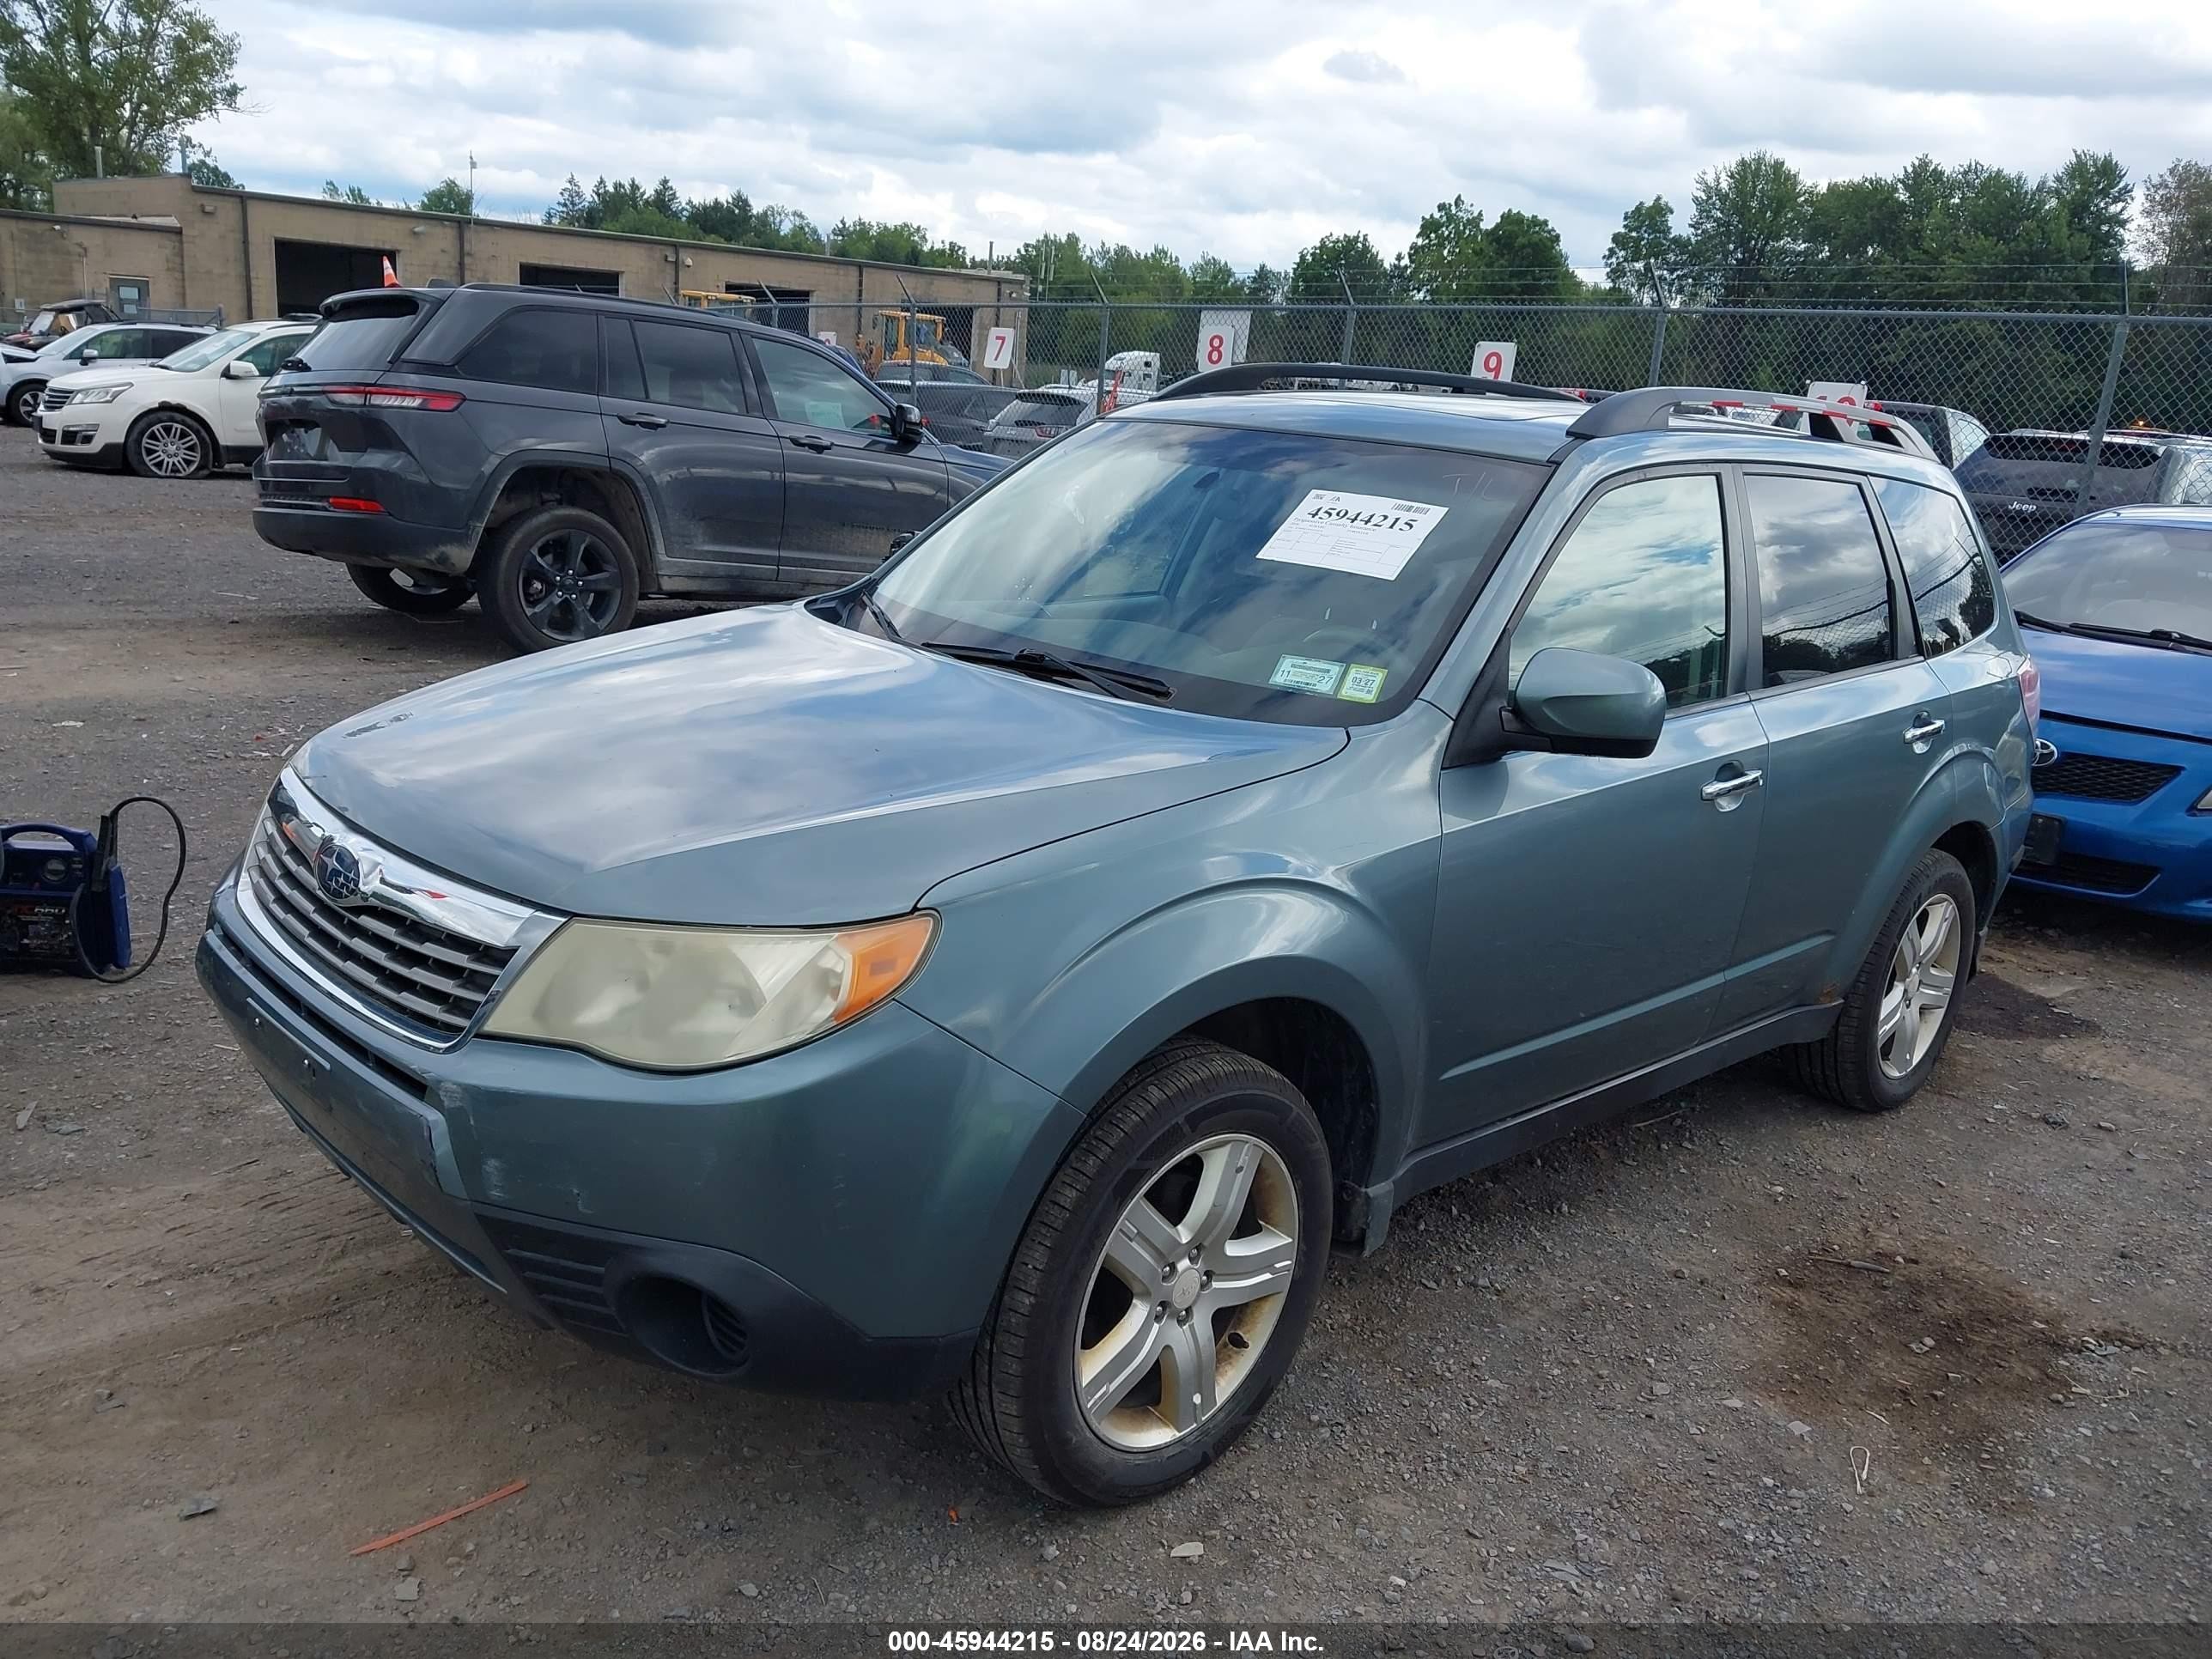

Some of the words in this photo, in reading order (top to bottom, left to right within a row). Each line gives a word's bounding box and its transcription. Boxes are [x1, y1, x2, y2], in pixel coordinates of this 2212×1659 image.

[994, 336, 1006, 361] 7
[1207, 334, 1224, 365] 8
[1483, 351, 1503, 380] 9
[1307, 506, 1419, 532] 45944215
[2008, 501, 2037, 513] Jeep
[1280, 669, 1291, 678] 11
[1317, 675, 1334, 684] 27
